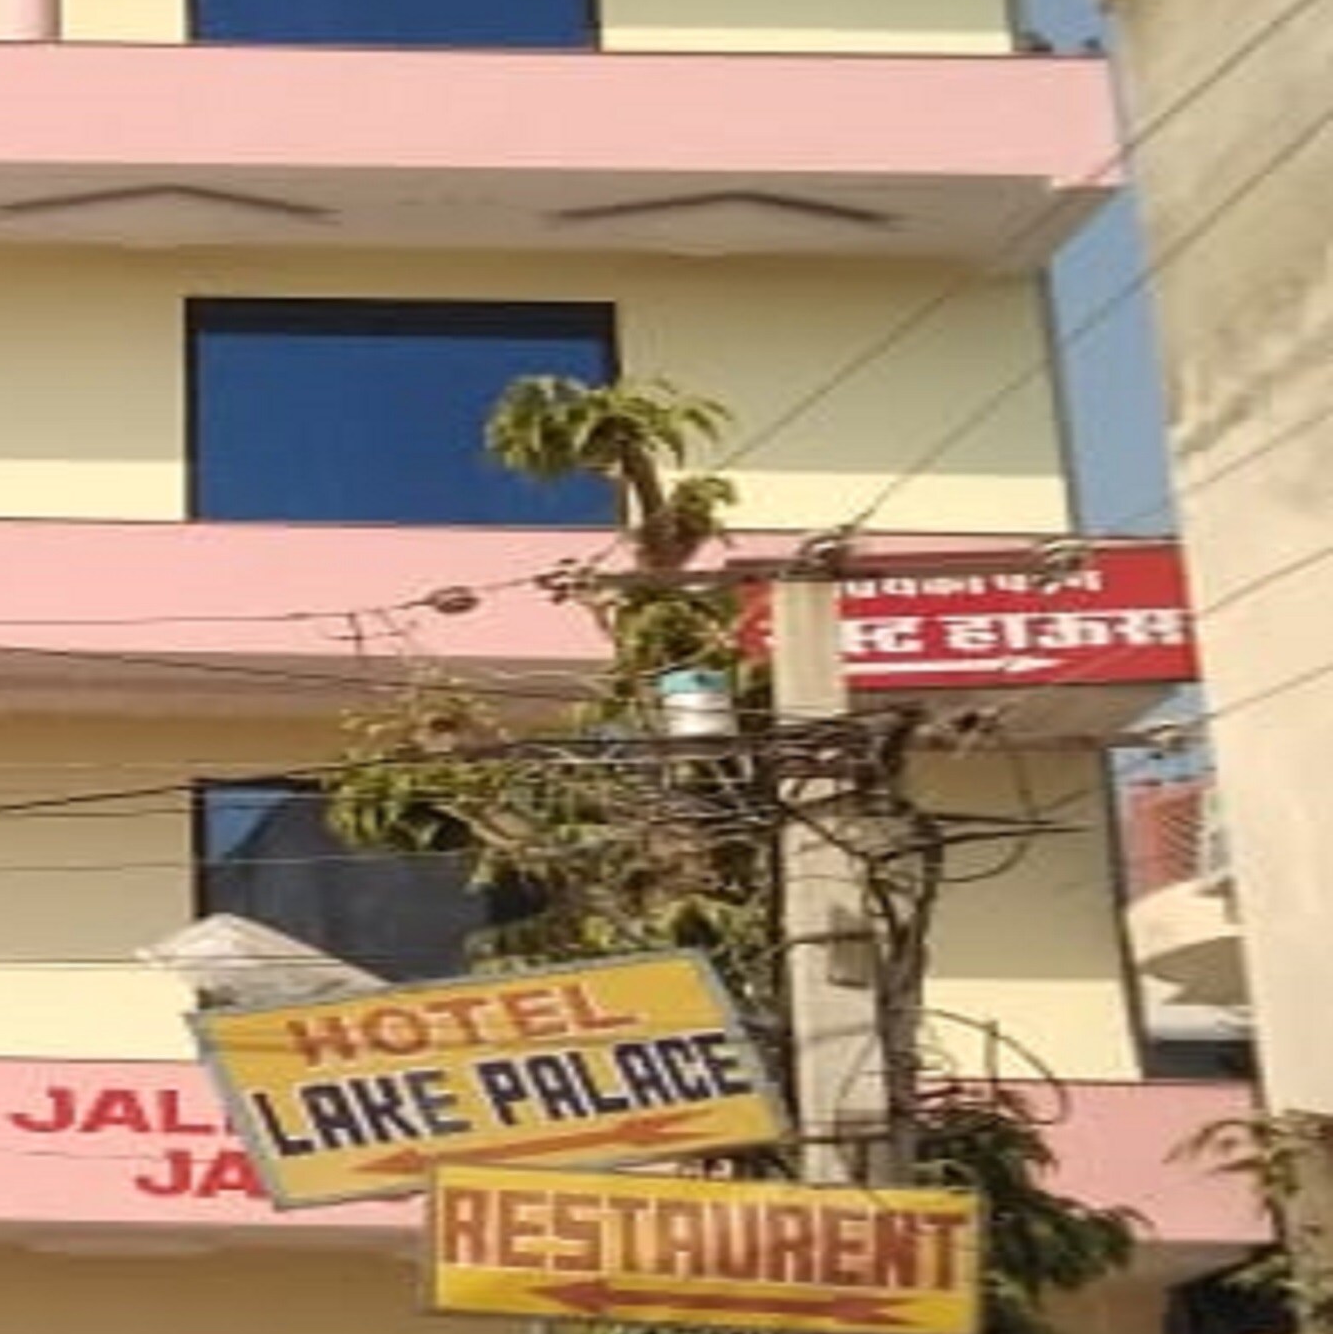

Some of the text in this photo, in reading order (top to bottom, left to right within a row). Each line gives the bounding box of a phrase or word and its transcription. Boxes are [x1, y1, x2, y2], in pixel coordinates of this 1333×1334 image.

[284, 977, 640, 1065] HOTEL
[9, 1087, 233, 1136] JAL
[250, 1029, 757, 1157] LAKE PALACE
[441, 1188, 971, 1292] RESTAURENT
